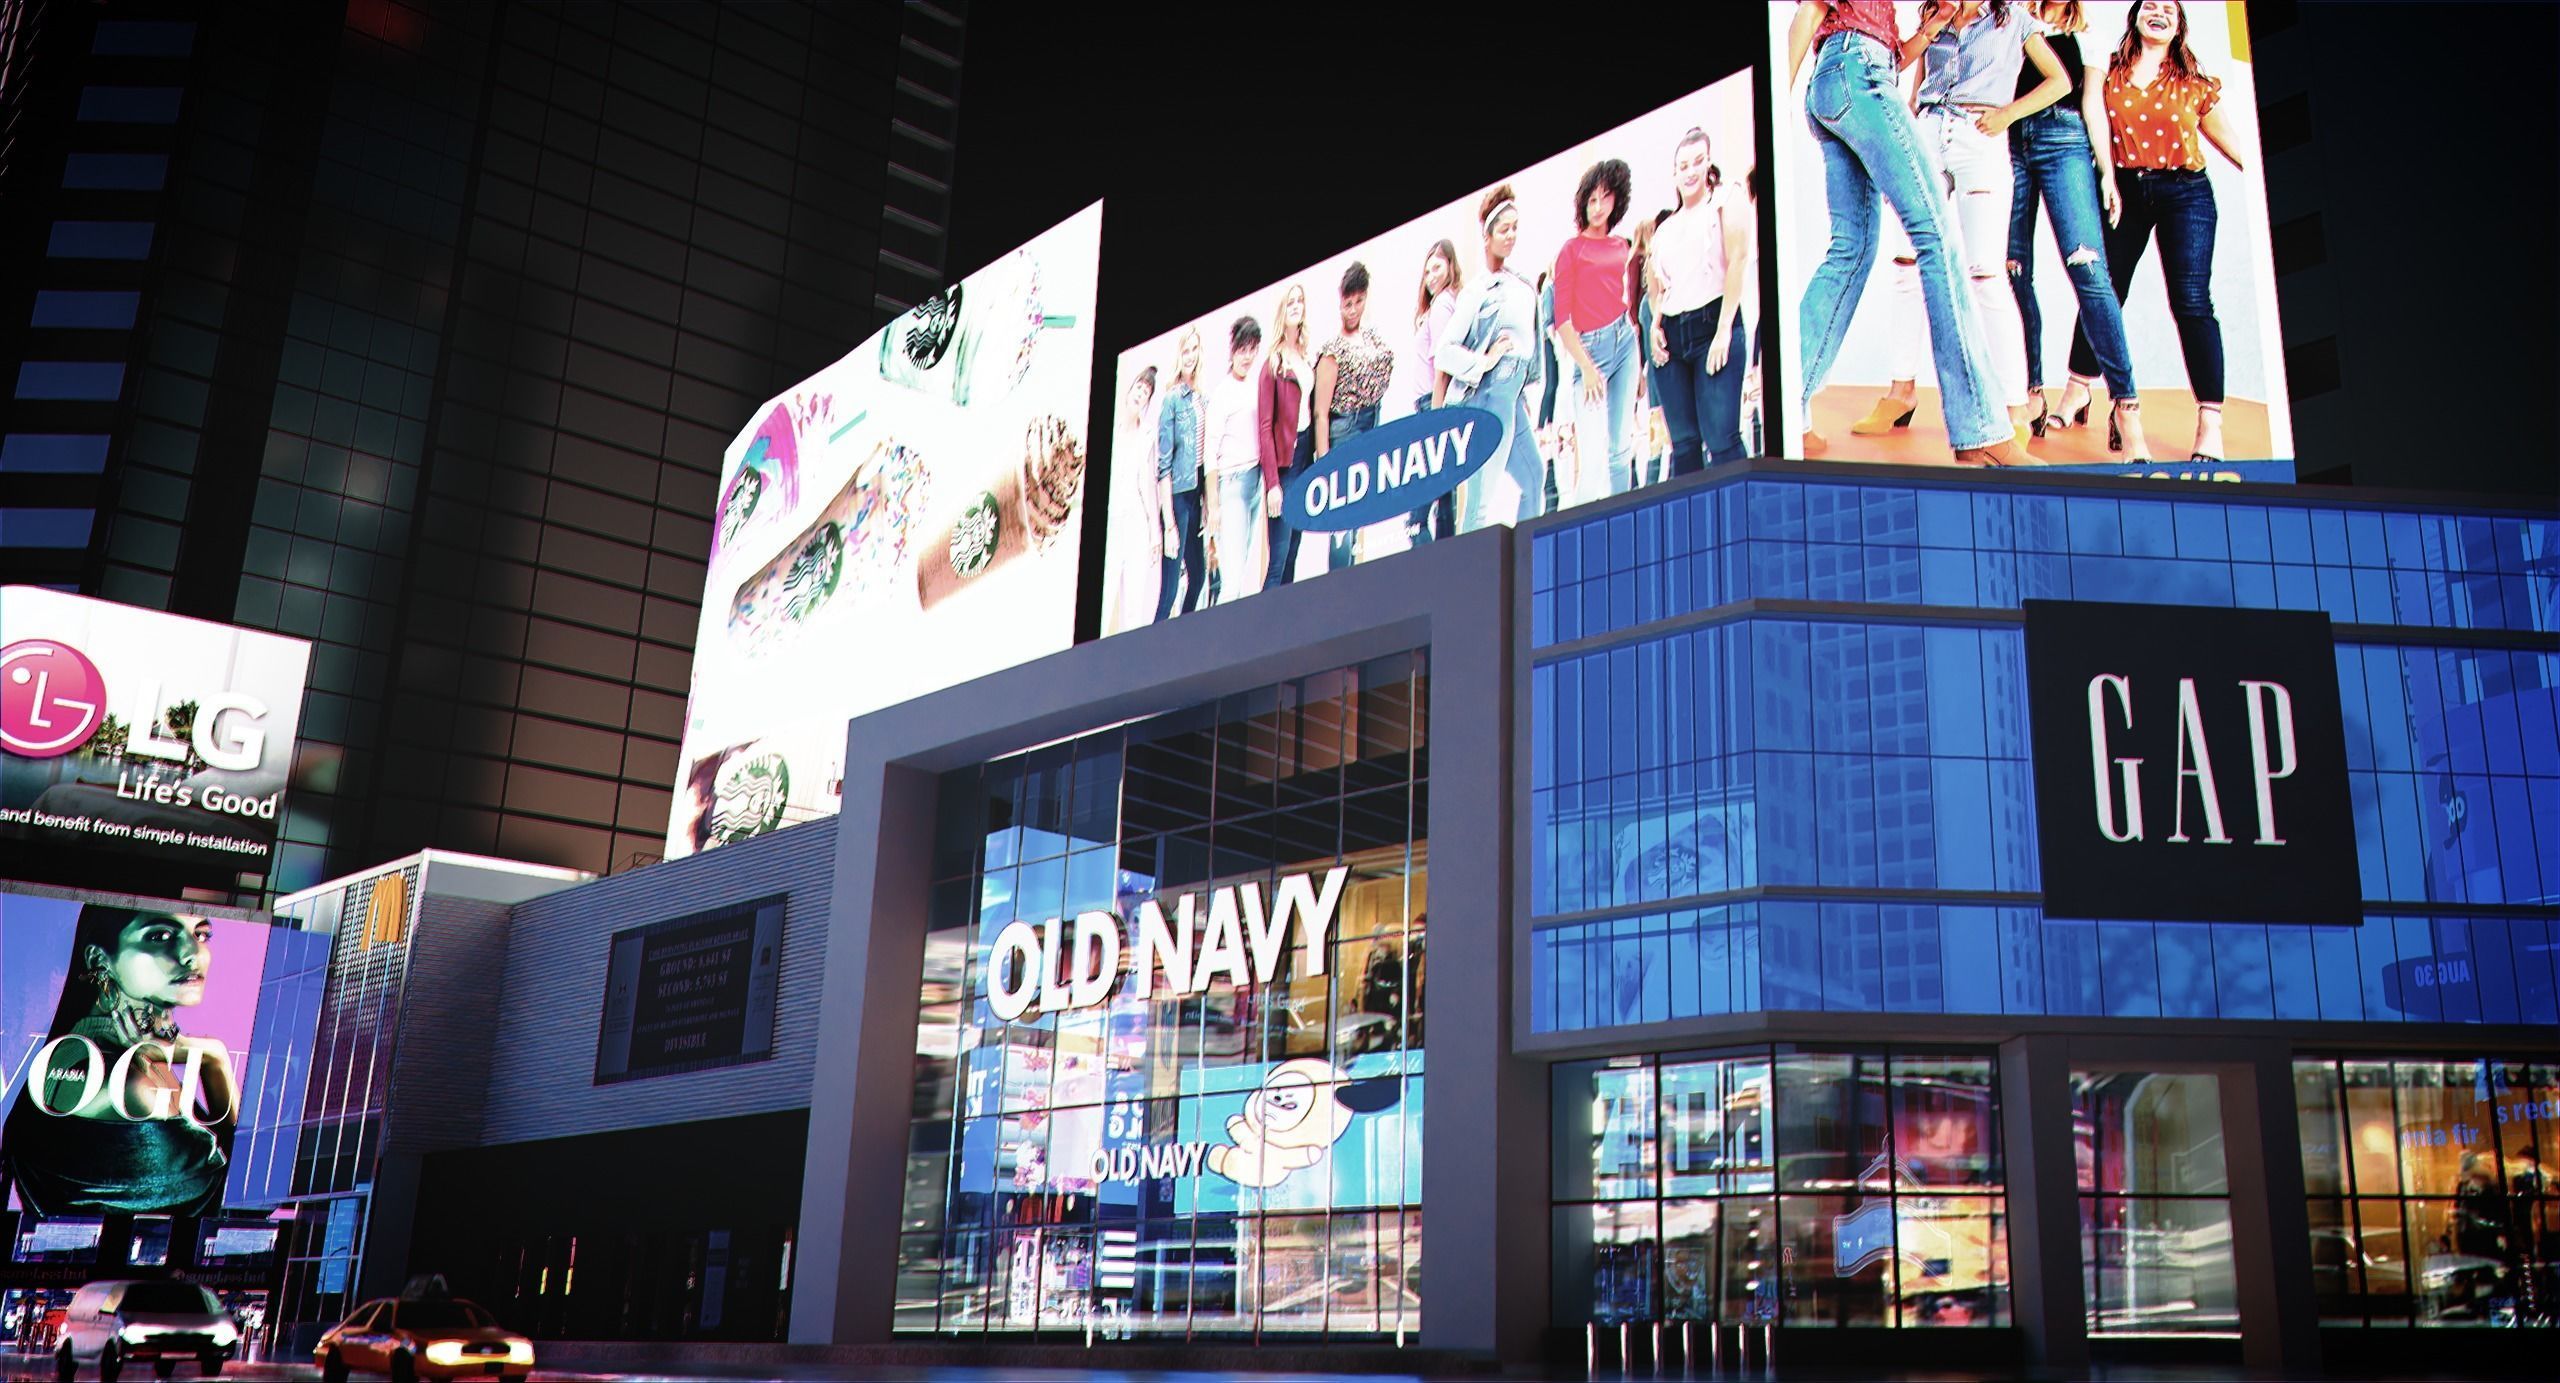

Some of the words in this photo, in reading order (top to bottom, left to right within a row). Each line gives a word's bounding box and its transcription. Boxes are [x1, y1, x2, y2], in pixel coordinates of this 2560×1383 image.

[1305, 461, 1370, 517] OLD
[1376, 421, 1475, 494] NAVY
[126, 678, 268, 771] LG
[2087, 673, 2298, 846] GAP
[116, 770, 192, 807] Life's
[201, 784, 278, 819] Good
[0, 808, 30, 823] and
[33, 810, 90, 832] benefit
[93, 818, 131, 838] from
[132, 826, 186, 847] simple
[187, 831, 268, 856] installation
[986, 910, 1123, 1022] OLD
[1137, 865, 1350, 1001] NAVY
[48, 1068, 86, 1083] ARABIA
[1089, 1147, 1136, 1185] OLD
[1140, 1141, 1212, 1181] NAVY
